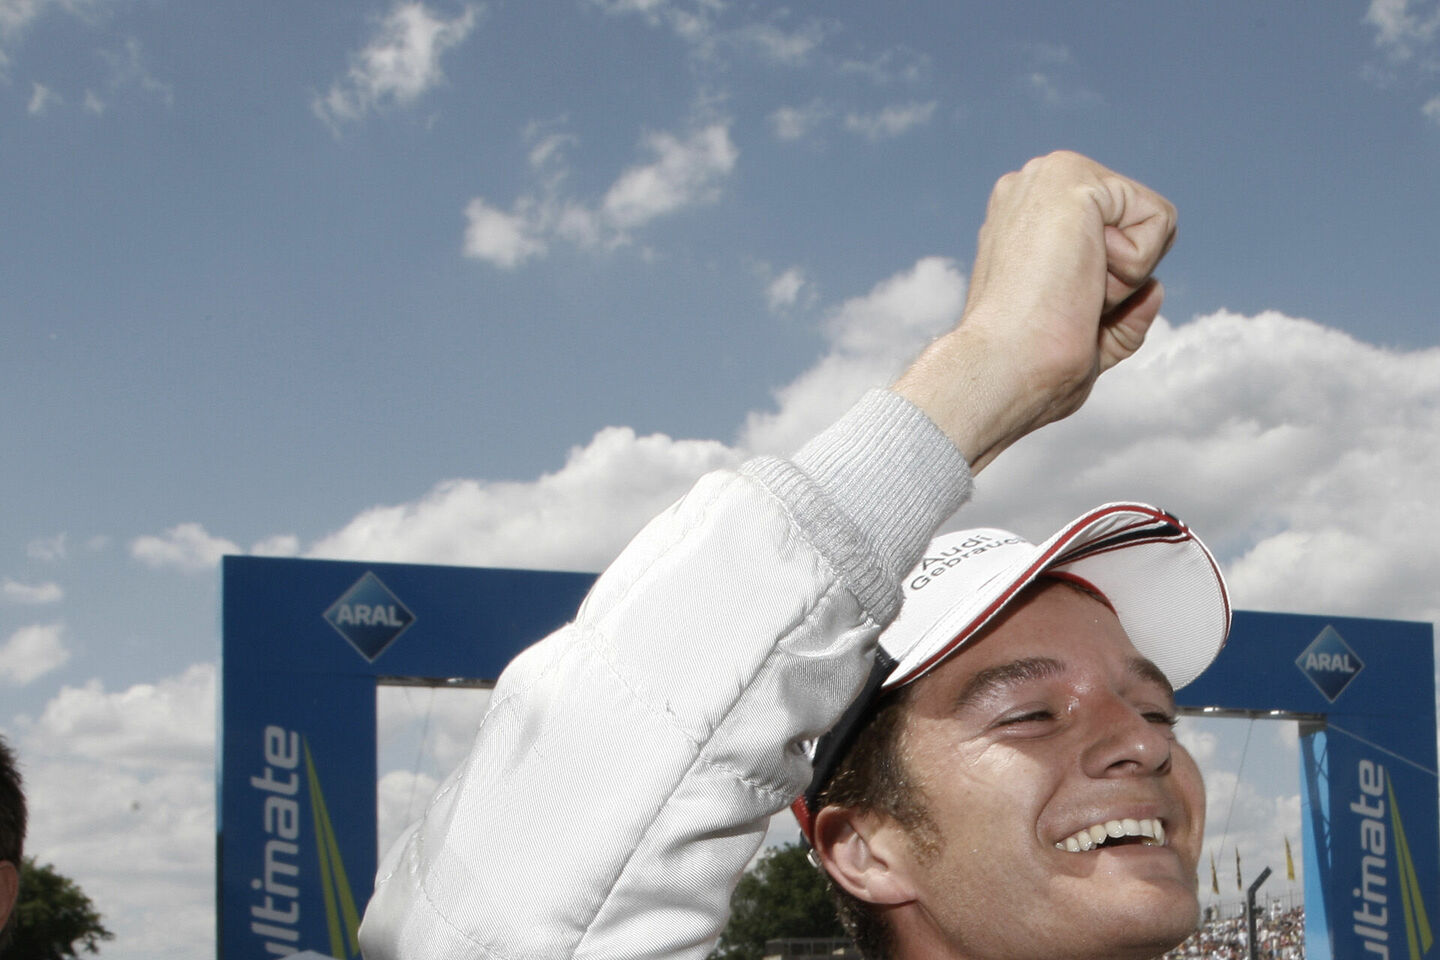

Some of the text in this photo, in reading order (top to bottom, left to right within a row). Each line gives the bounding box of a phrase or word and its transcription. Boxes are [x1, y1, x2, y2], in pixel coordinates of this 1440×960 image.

[910, 538, 1027, 591] Gebrauc
[920, 533, 993, 571] Audi
[336, 604, 403, 627] ARAL
[1304, 653, 1355, 673] ARAL
